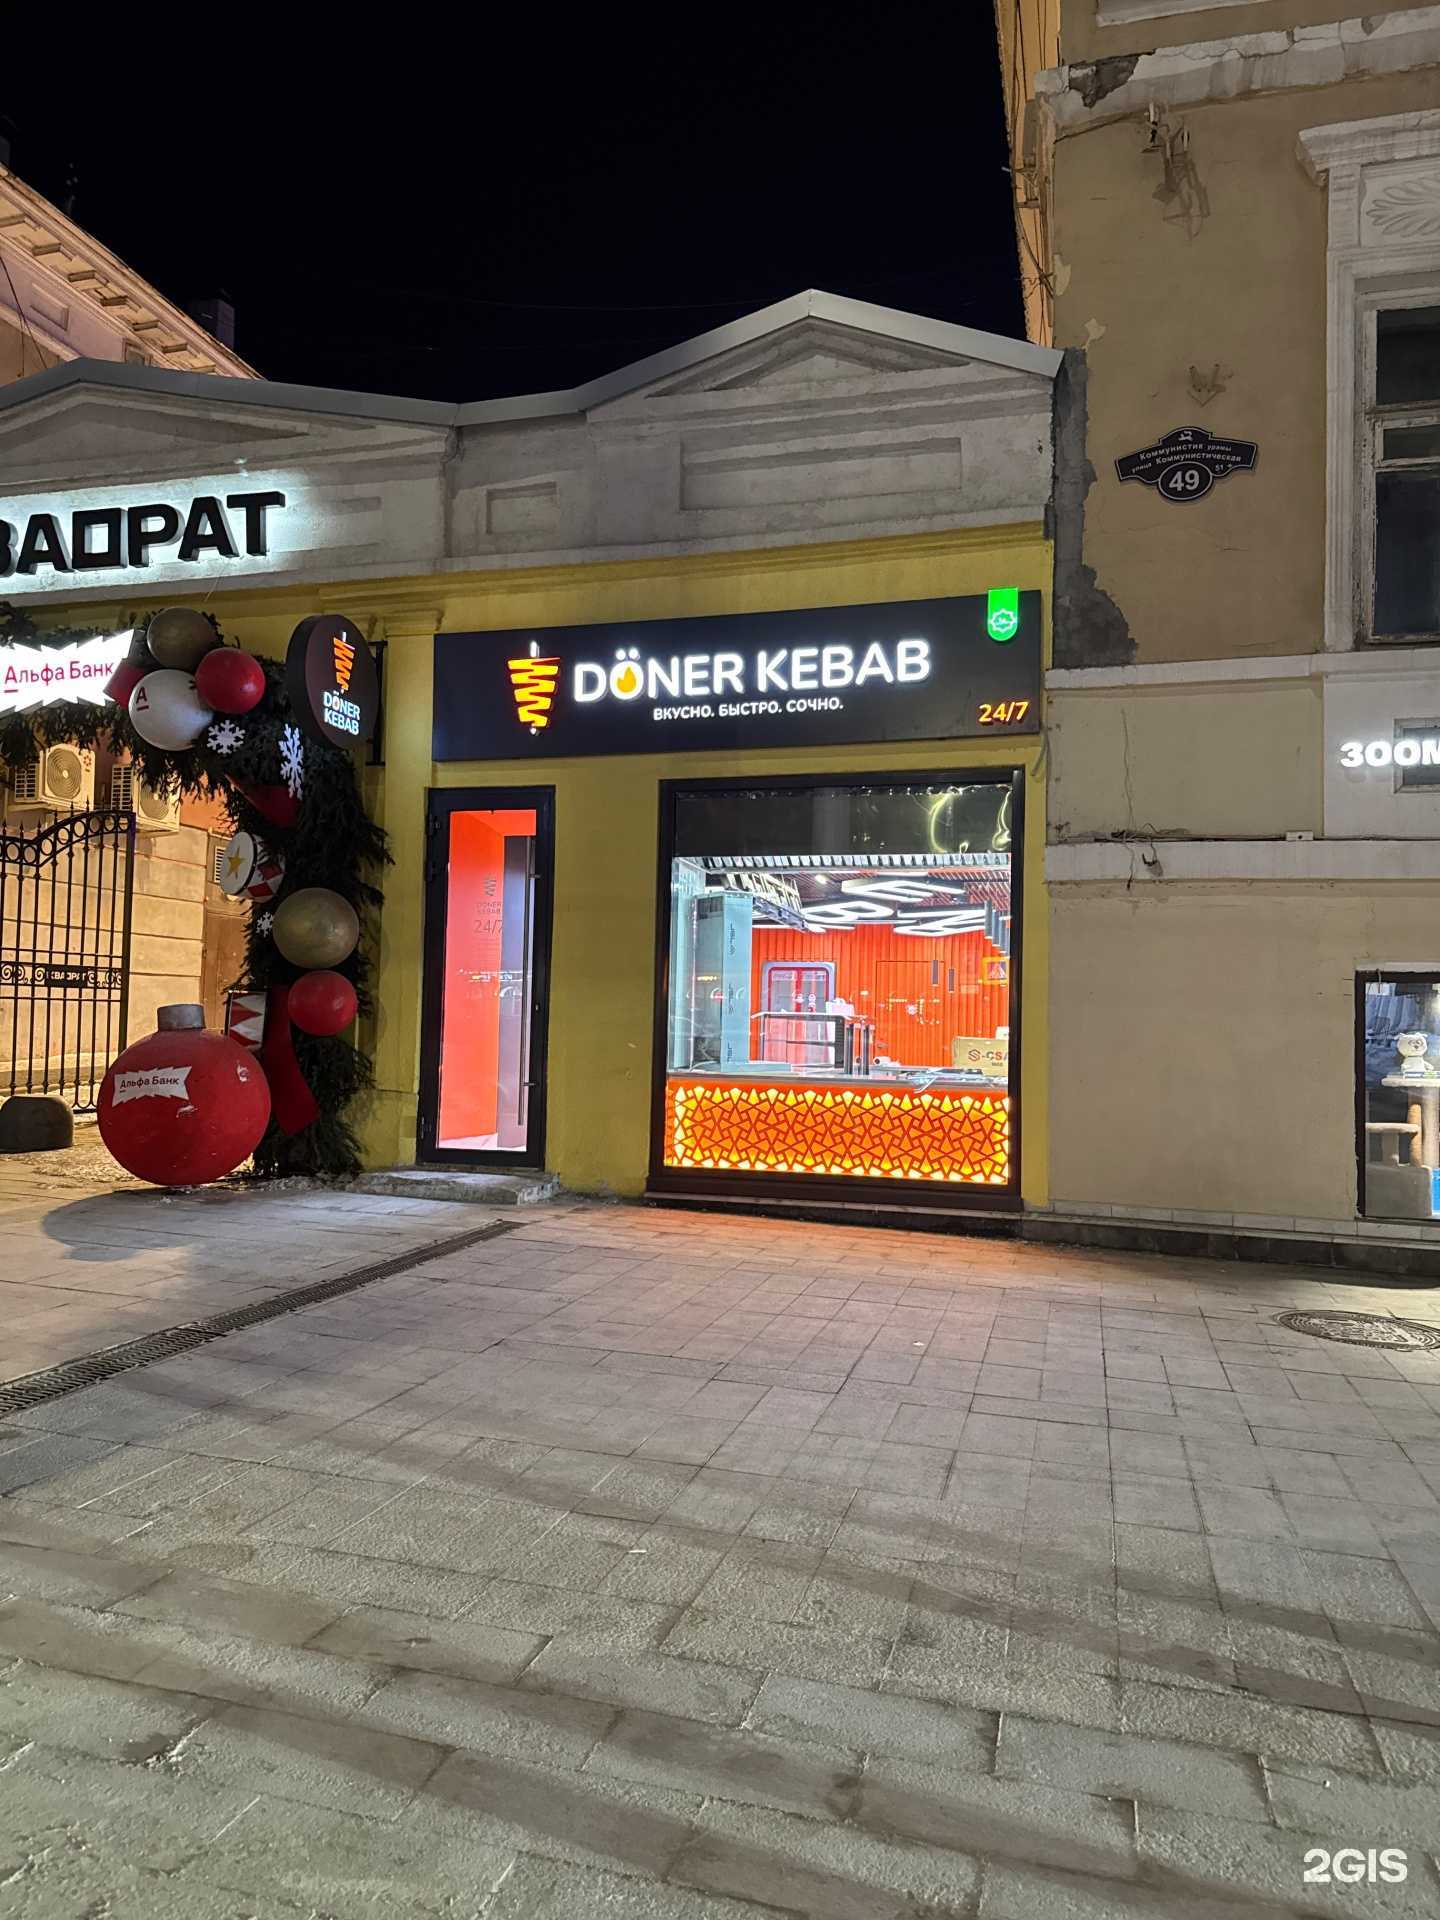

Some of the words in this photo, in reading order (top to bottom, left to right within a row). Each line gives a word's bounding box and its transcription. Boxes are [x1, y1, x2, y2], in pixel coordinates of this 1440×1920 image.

[1131, 462, 1152, 474] улица
[1156, 452, 1242, 465] Коммунистическая
[1168, 470, 1200, 491] 49
[4, 662, 64, 692] Альфа
[69, 660, 114, 680] Банк
[574, 649, 743, 702] DÖNER
[757, 640, 931, 693] KEBAB
[323, 690, 360, 720] DÖNER
[653, 703, 715, 721] ВКУСНО.
[718, 700, 782, 718] БЫСТРО.
[785, 697, 844, 713] СОЧНО.
[979, 701, 1029, 722] 24/7
[324, 708, 359, 735] KEBAB
[474, 920, 502, 935] 24/7
[120, 1078, 150, 1092] Альфа
[152, 1076, 180, 1086] Банк
